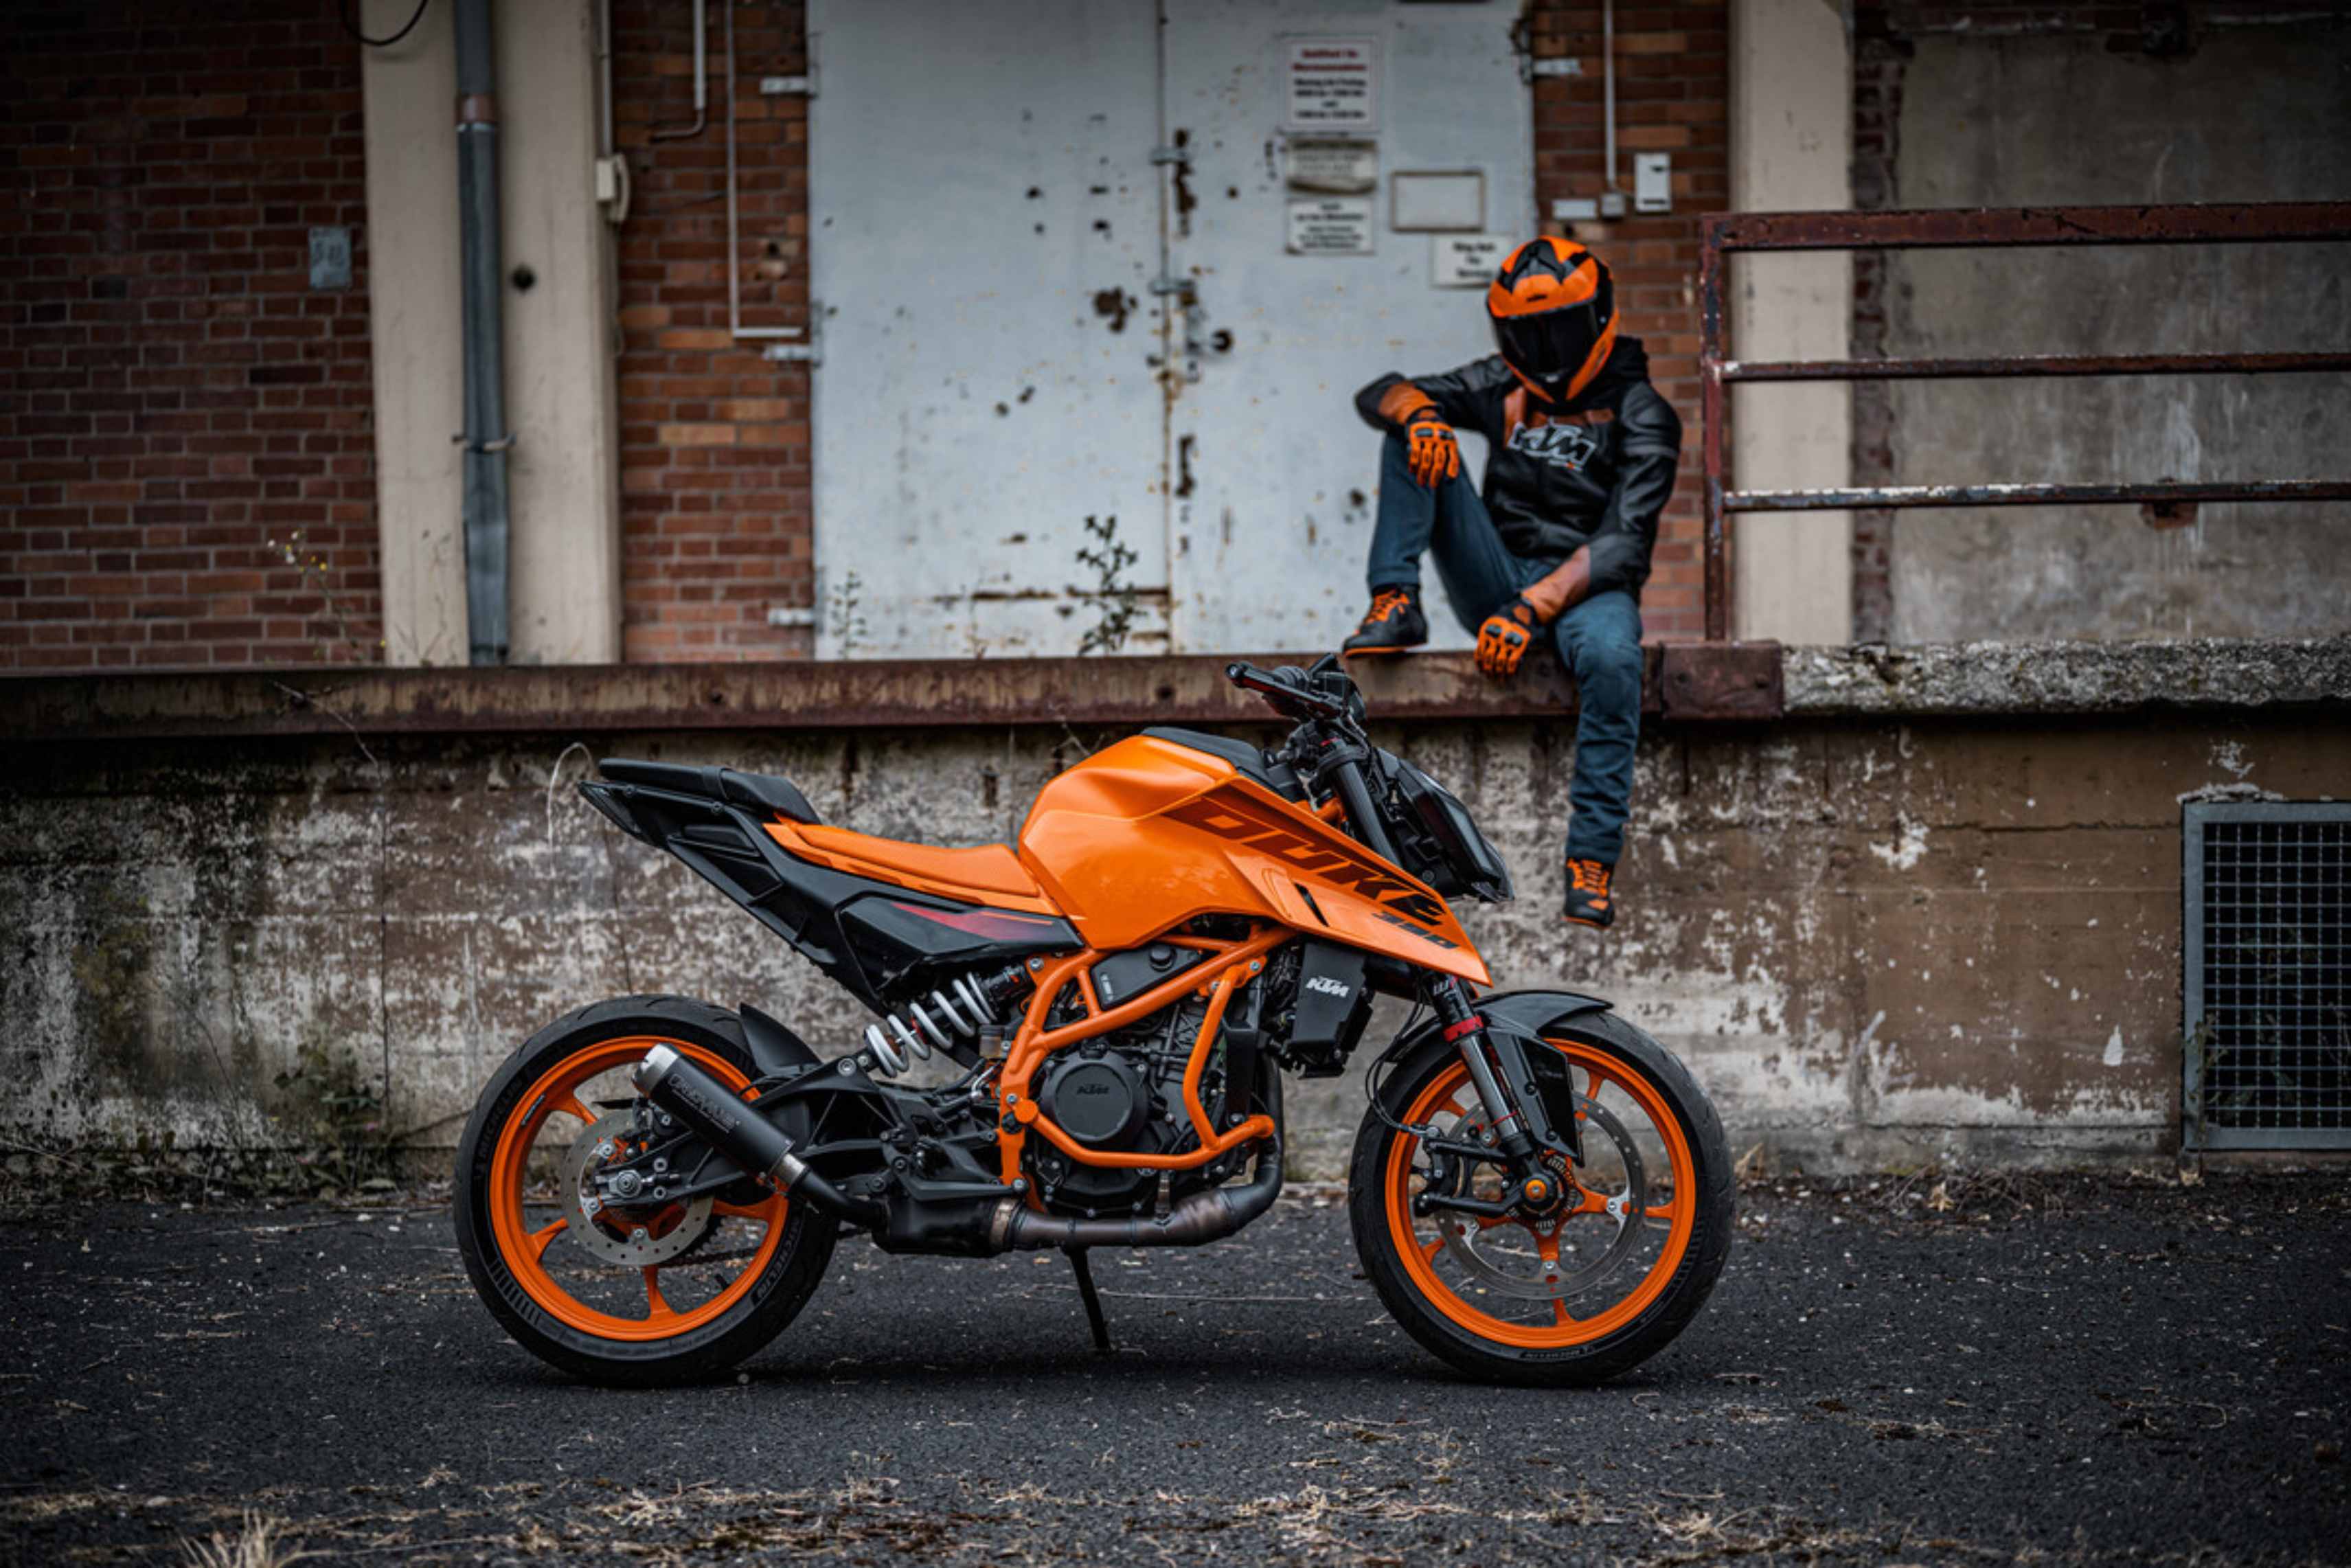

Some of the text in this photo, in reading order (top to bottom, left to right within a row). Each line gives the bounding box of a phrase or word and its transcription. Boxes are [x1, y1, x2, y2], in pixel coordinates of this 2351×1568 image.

[1507, 418, 1597, 466] KTM
[1159, 795, 1447, 926] DUKE
[1306, 975, 1350, 998] KTM
[1076, 1083, 1109, 1095] KTM
